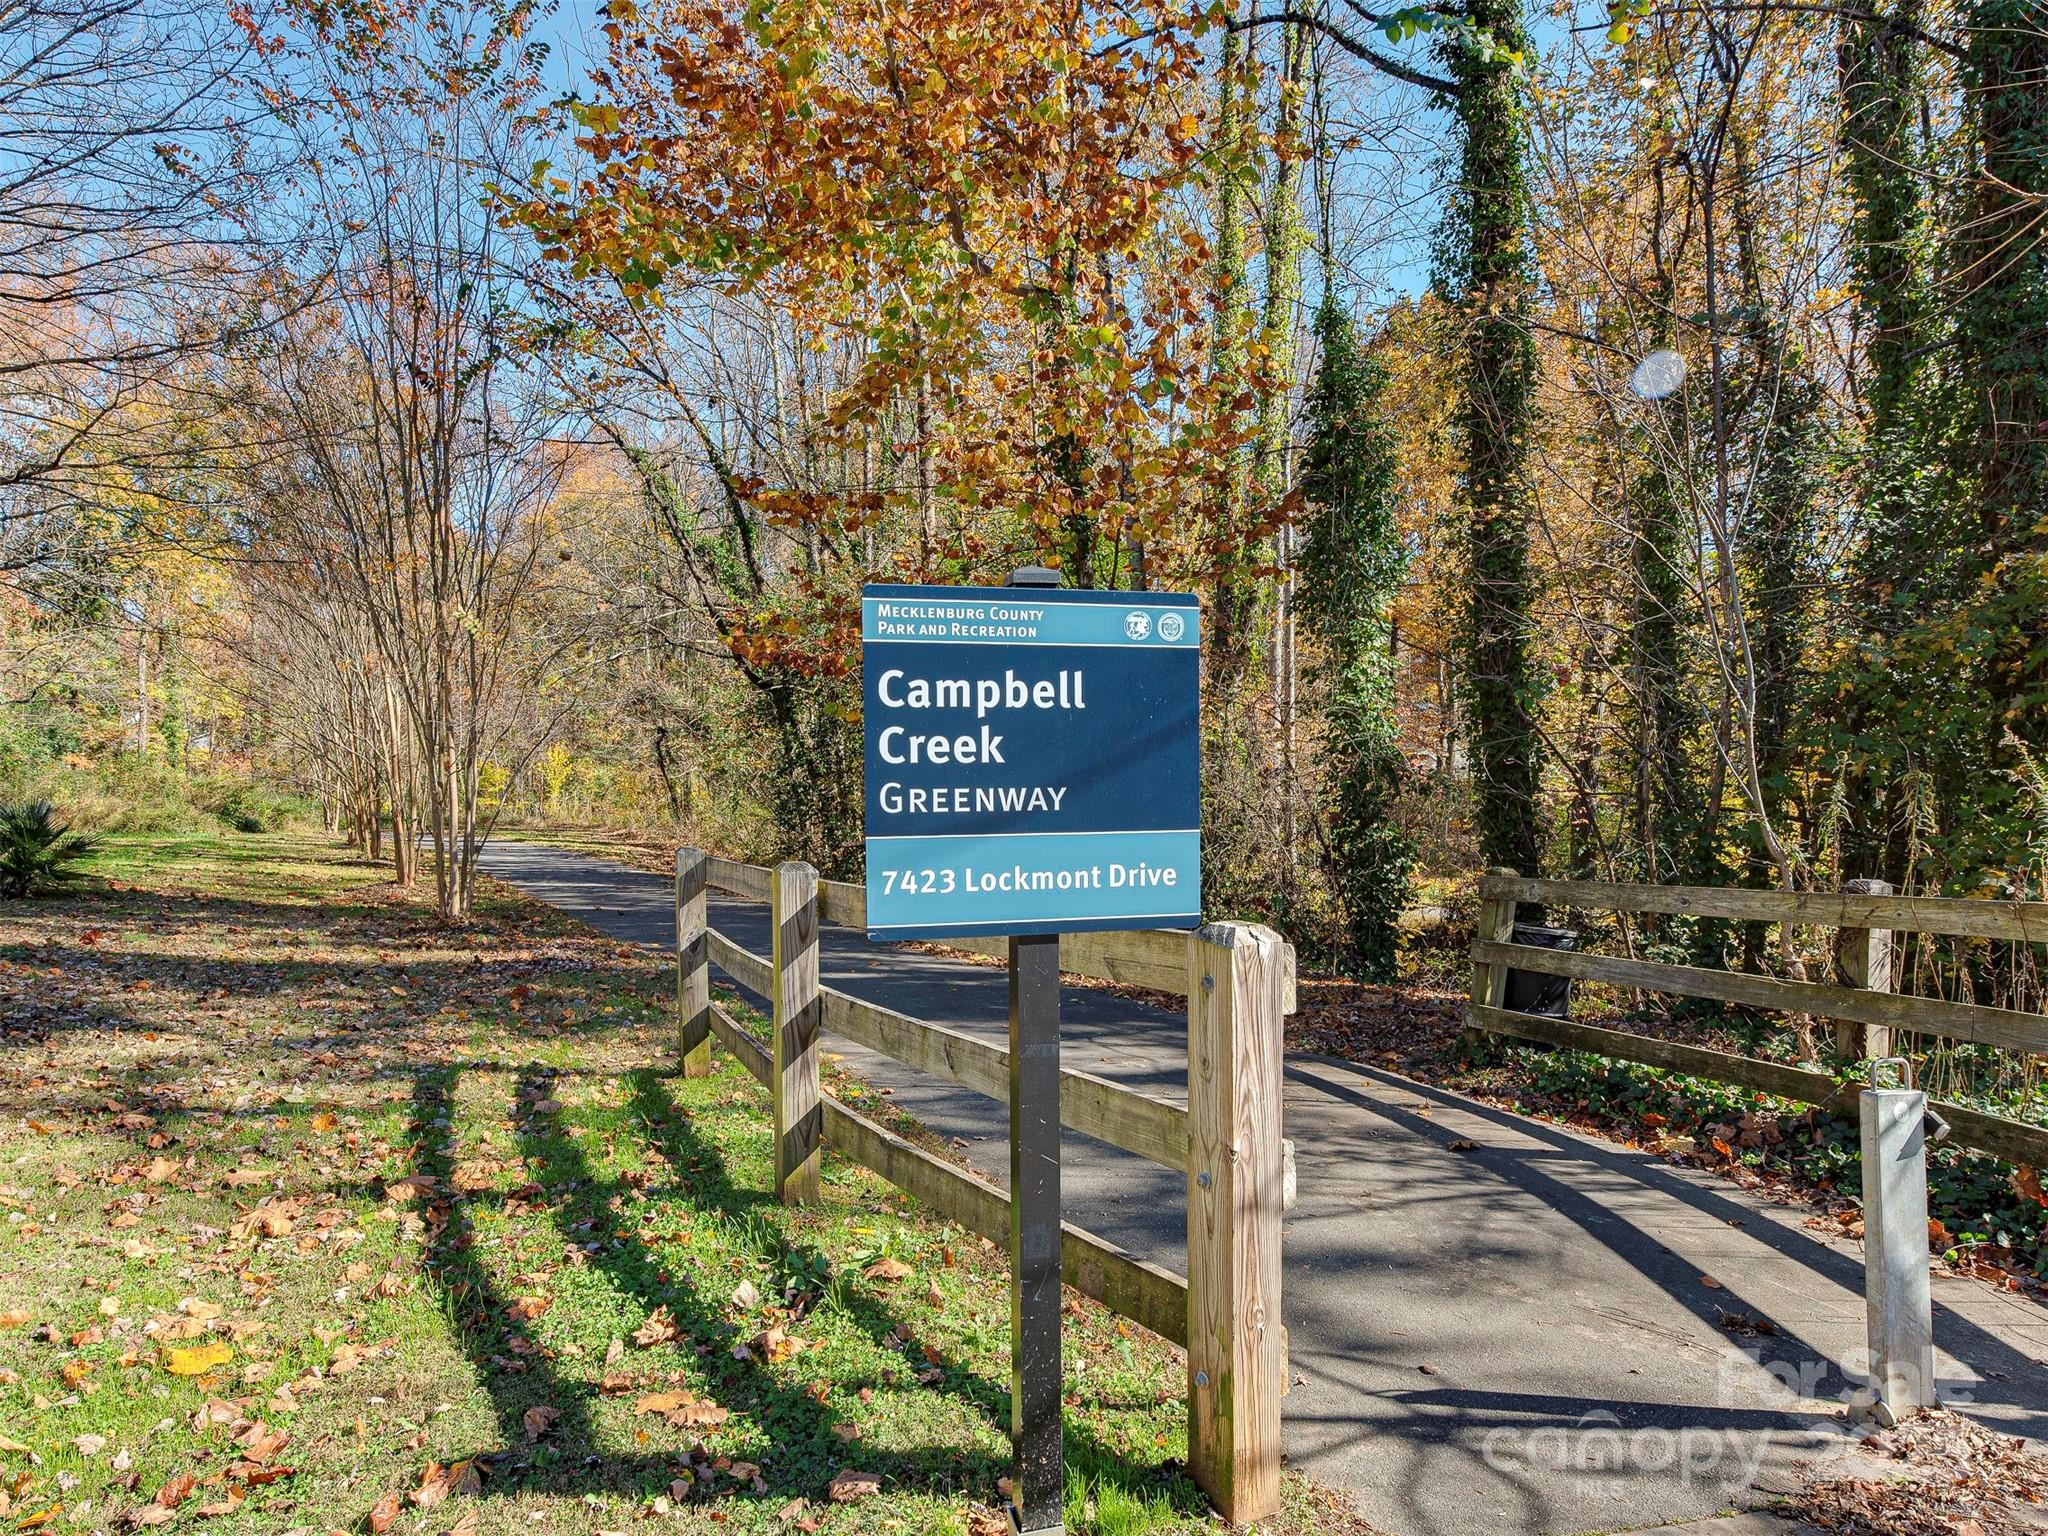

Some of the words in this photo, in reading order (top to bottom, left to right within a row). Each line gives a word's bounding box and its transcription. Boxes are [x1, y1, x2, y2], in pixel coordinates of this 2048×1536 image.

[877, 602, 986, 620] MECKLENBURG
[988, 606, 1045, 622] COUNTY
[877, 621, 916, 635] PARK
[918, 624, 947, 636] AND
[950, 622, 1038, 638] RECREATION
[878, 669, 1086, 718] Campbell
[878, 725, 1005, 764] Creek
[879, 782, 1068, 814] GREENWAY
[881, 869, 956, 896] 7423
[964, 865, 1102, 893] Lockmont
[1109, 862, 1178, 888] Drive
